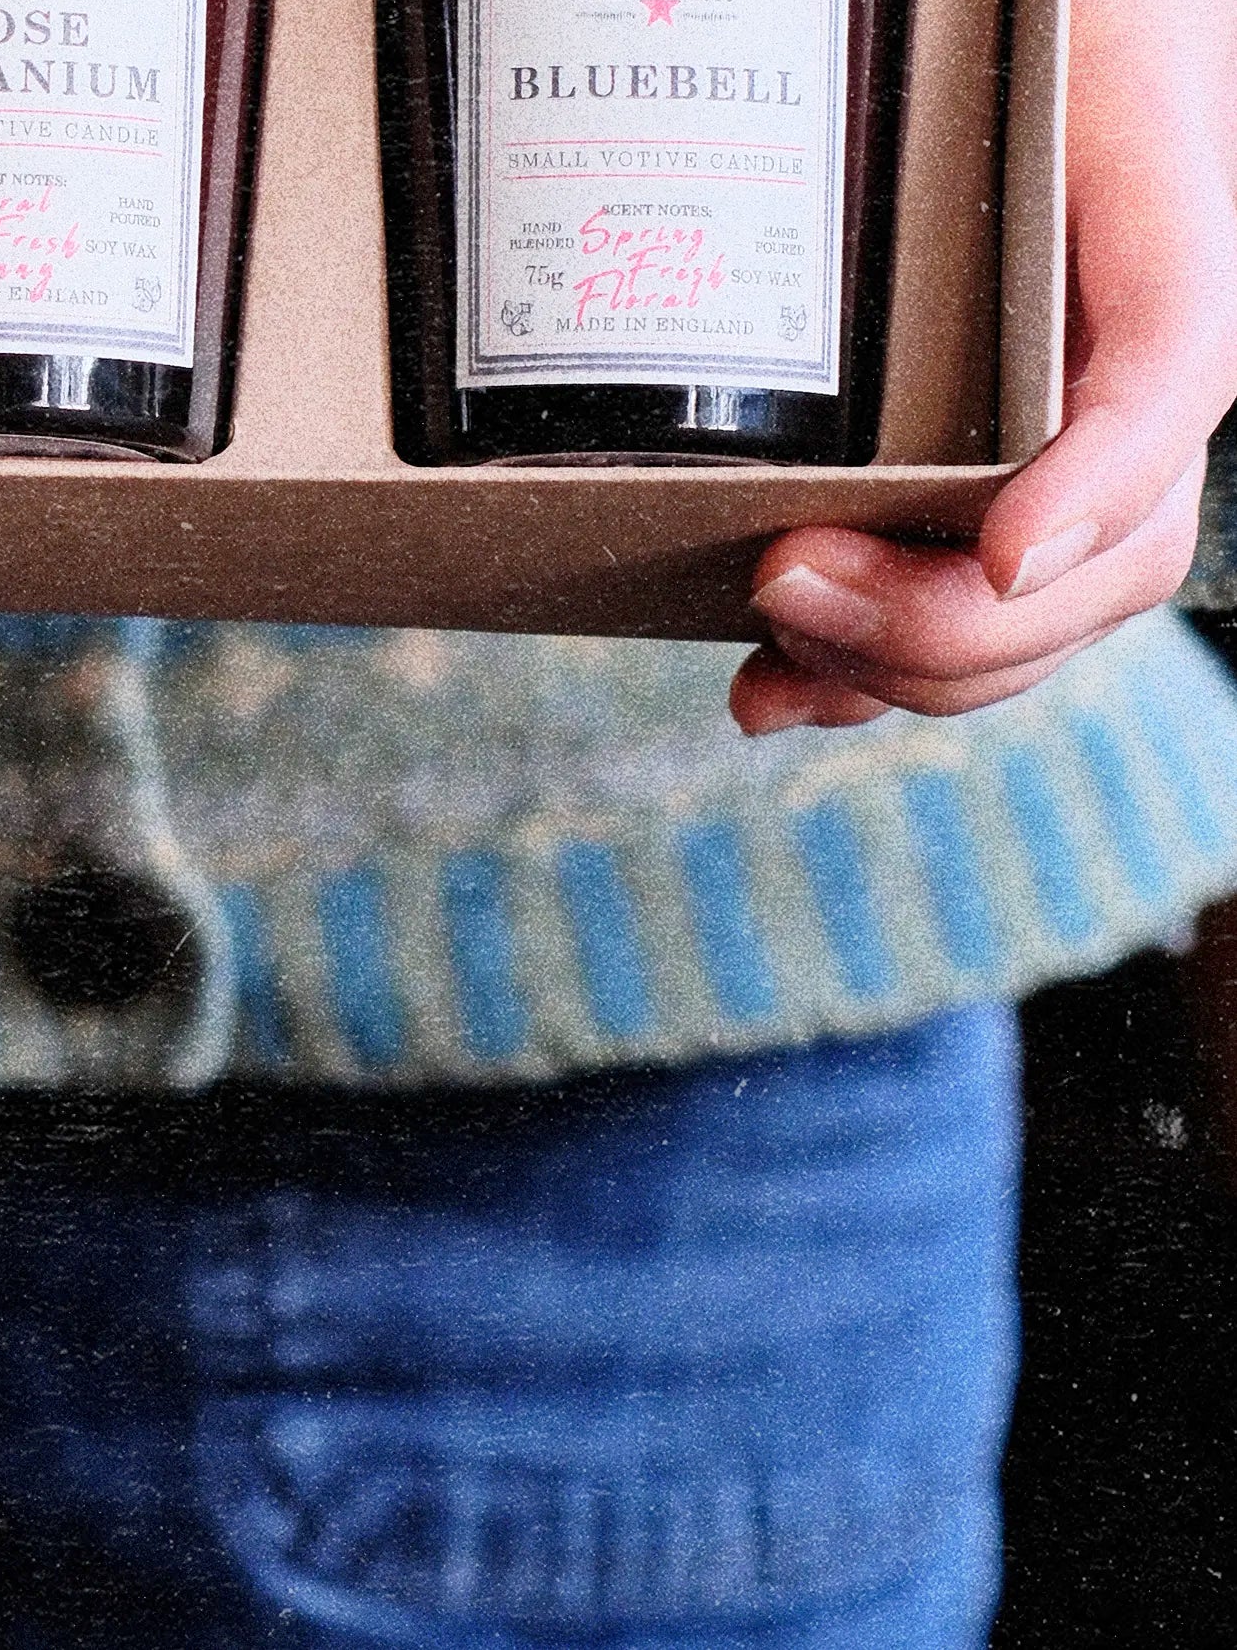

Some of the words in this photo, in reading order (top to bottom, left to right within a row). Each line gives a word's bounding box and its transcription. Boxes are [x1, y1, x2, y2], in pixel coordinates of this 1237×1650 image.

[510, 65, 802, 106] BLUEBELL
[65, 123, 159, 146] CANDLE
[508, 152, 588, 168] SMALL
[602, 152, 697, 168] VOTIVE
[710, 153, 803, 175] CANDLE
[12, 174, 67, 187] NOTES:
[119, 197, 154, 210] HAND
[603, 204, 652, 217] SCENT
[658, 205, 712, 218] NOTES:
[110, 212, 160, 227] POURED
[522, 223, 562, 233] HAND
[579, 207, 705, 262] Spring
[764, 227, 798, 239] HAND
[85, 241, 116, 254] SOY
[123, 243, 157, 259] WAX
[755, 242, 805, 255] POURED
[525, 265, 564, 288] 75g
[731, 270, 761, 283] SOY
[768, 272, 802, 286] WAX
[8, 286, 109, 305] ENGLAND
[573, 269, 701, 327] Floral
[555, 317, 615, 332] MADE
[622, 317, 647, 331] IN
[656, 317, 754, 335] ENGLAND
